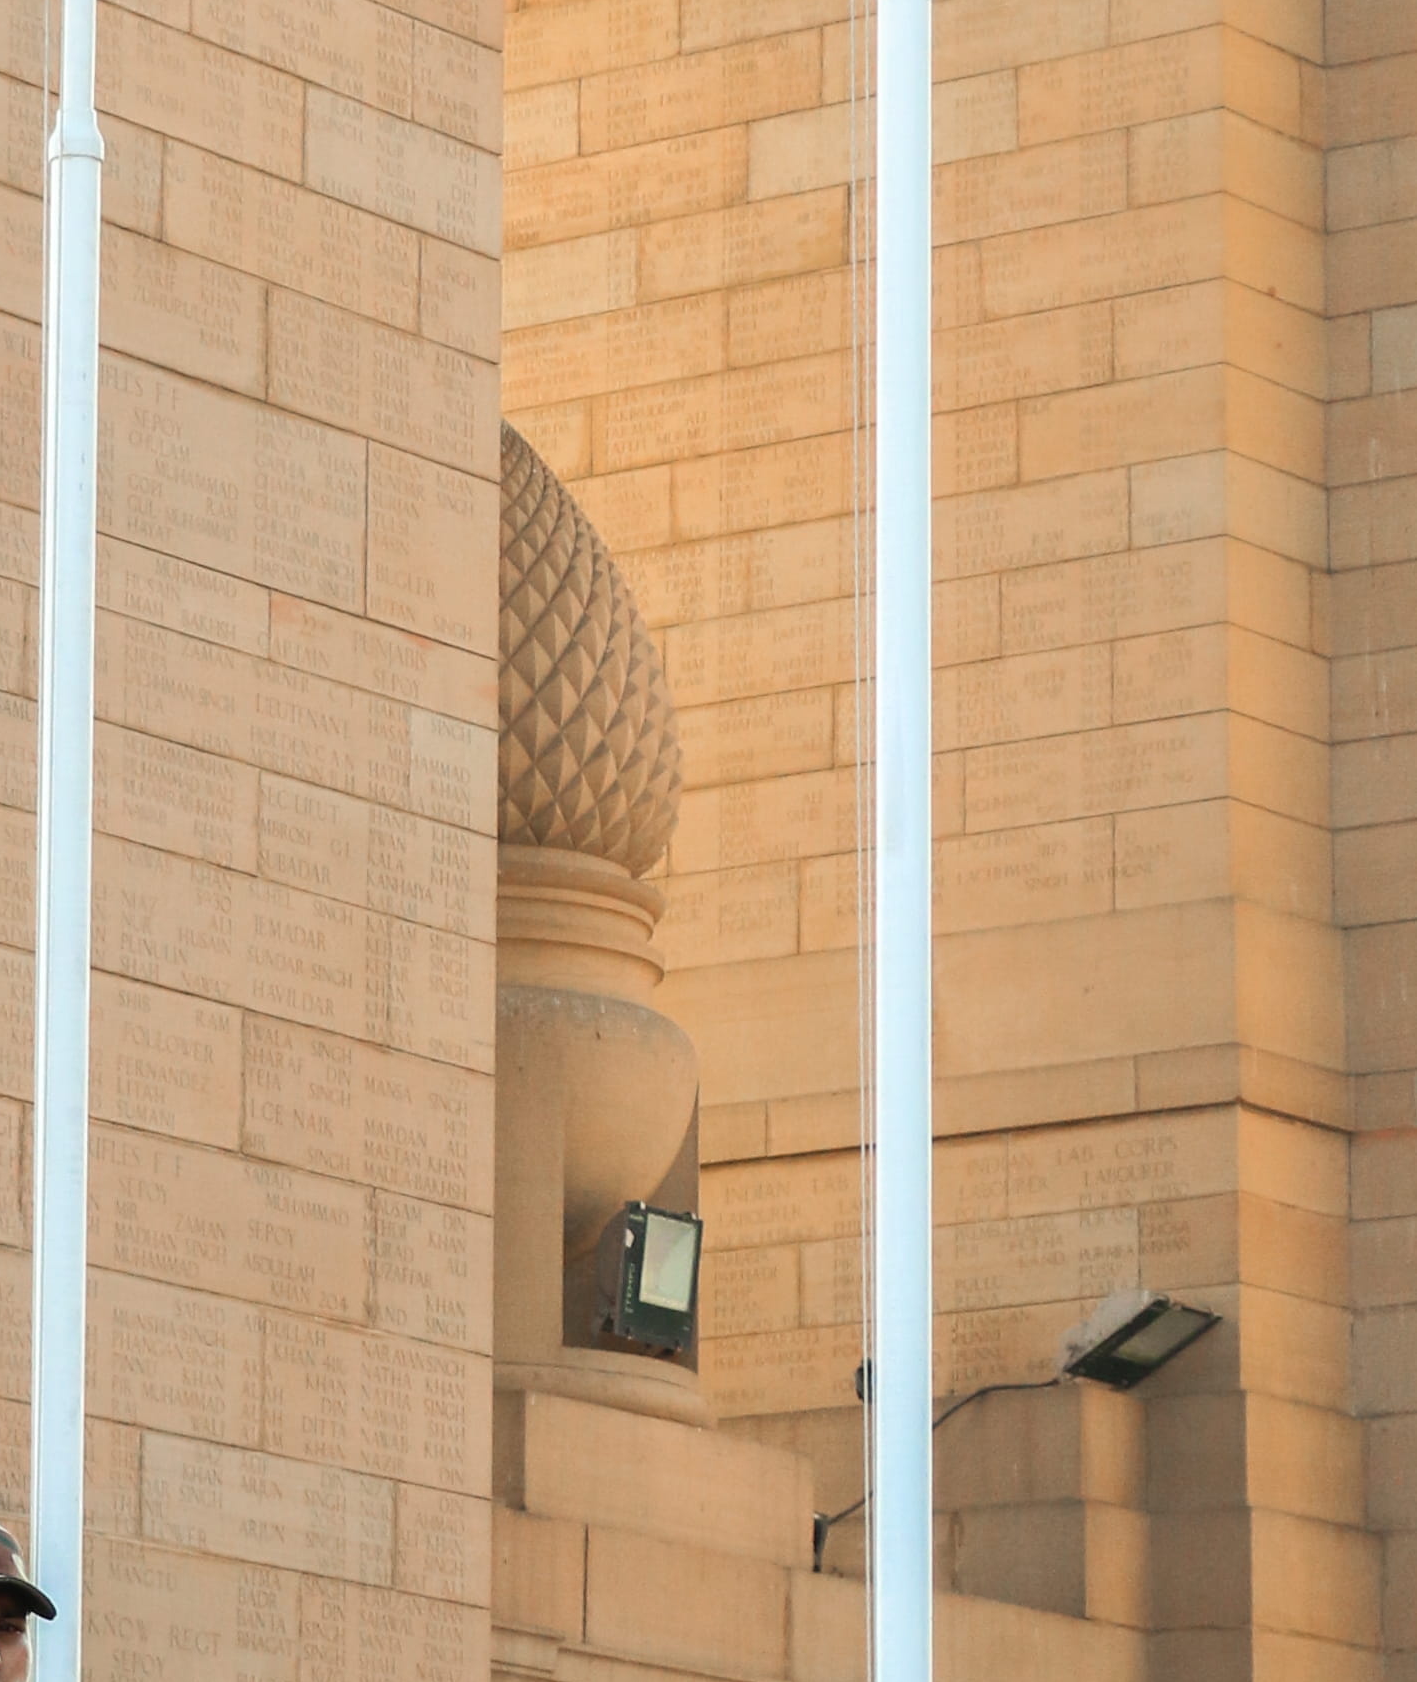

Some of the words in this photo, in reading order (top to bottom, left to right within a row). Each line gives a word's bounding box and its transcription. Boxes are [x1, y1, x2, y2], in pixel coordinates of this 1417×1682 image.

[254, 914, 326, 951] JEMADAR
[253, 979, 334, 1016] HAVILDAR
[250, 1096, 283, 1126] LCE
[293, 1109, 333, 1139] NAIK
[365, 1117, 427, 1148] MARDAN
[247, 1219, 295, 1249] SEPOY
